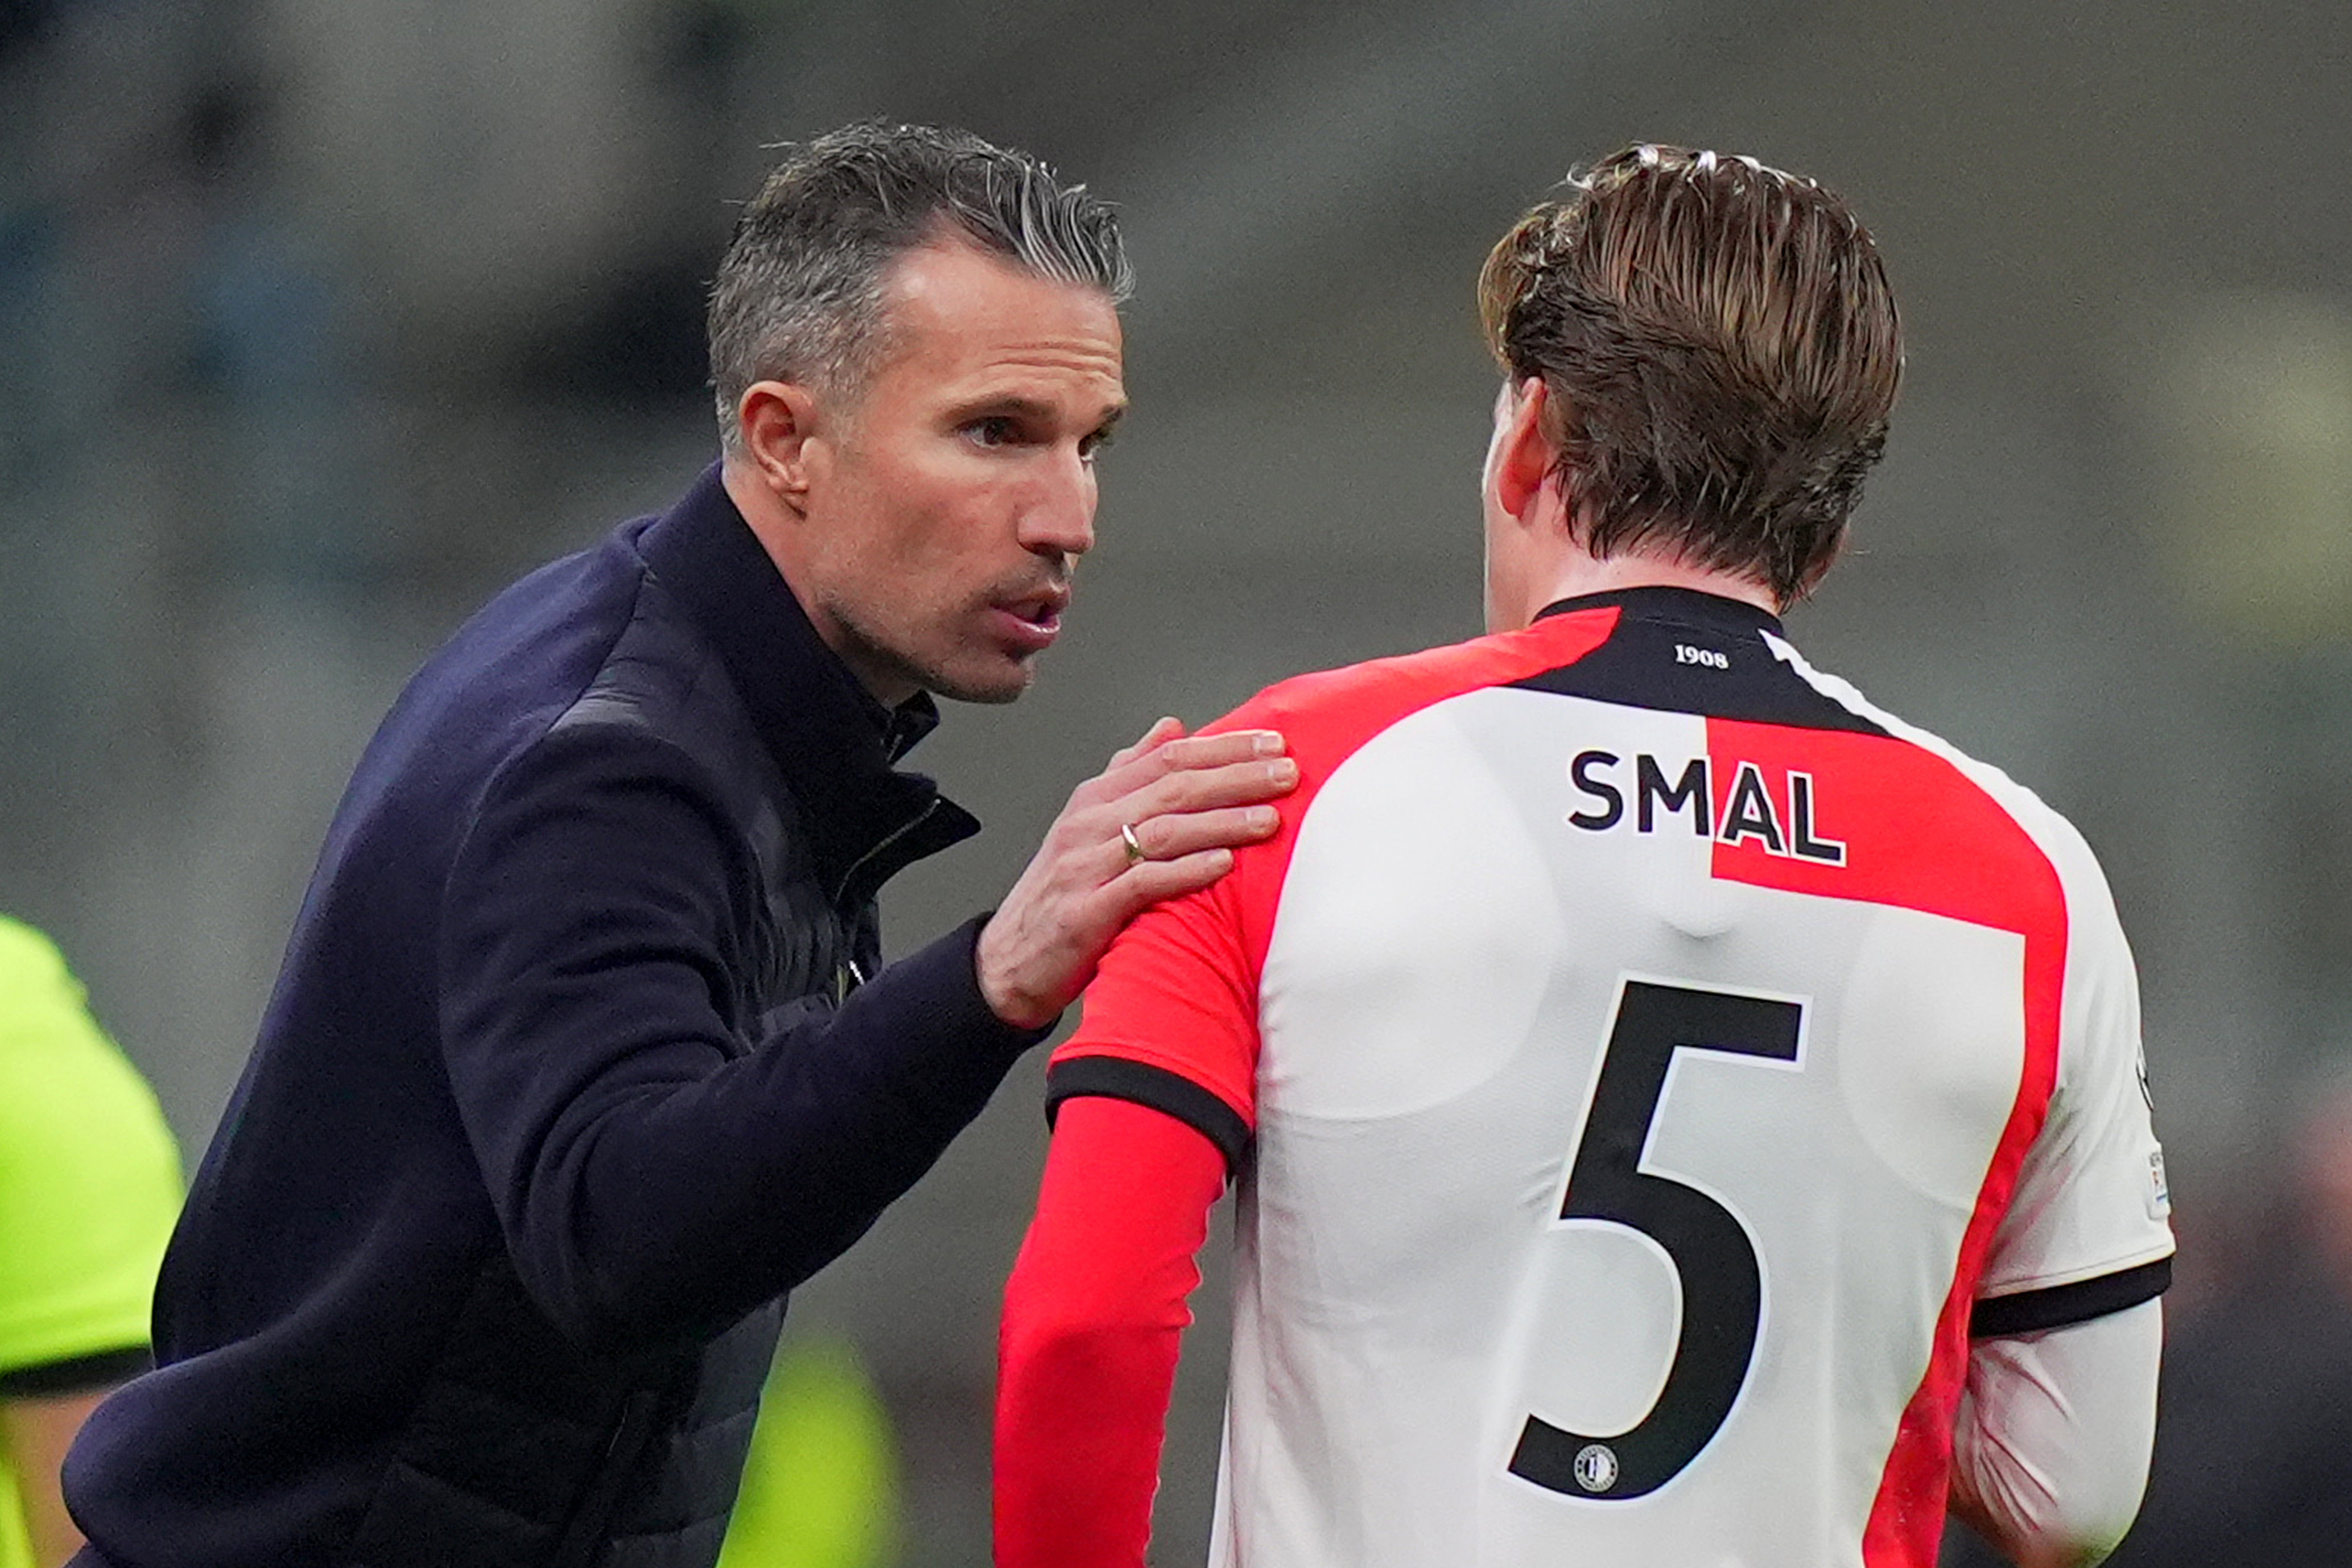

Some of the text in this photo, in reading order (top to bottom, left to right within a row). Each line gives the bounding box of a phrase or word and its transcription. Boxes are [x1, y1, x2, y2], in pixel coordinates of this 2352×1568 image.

[1674, 644, 1729, 670] 1908
[1566, 749, 1847, 868] SMAL
[1503, 975, 1808, 1504] 5
